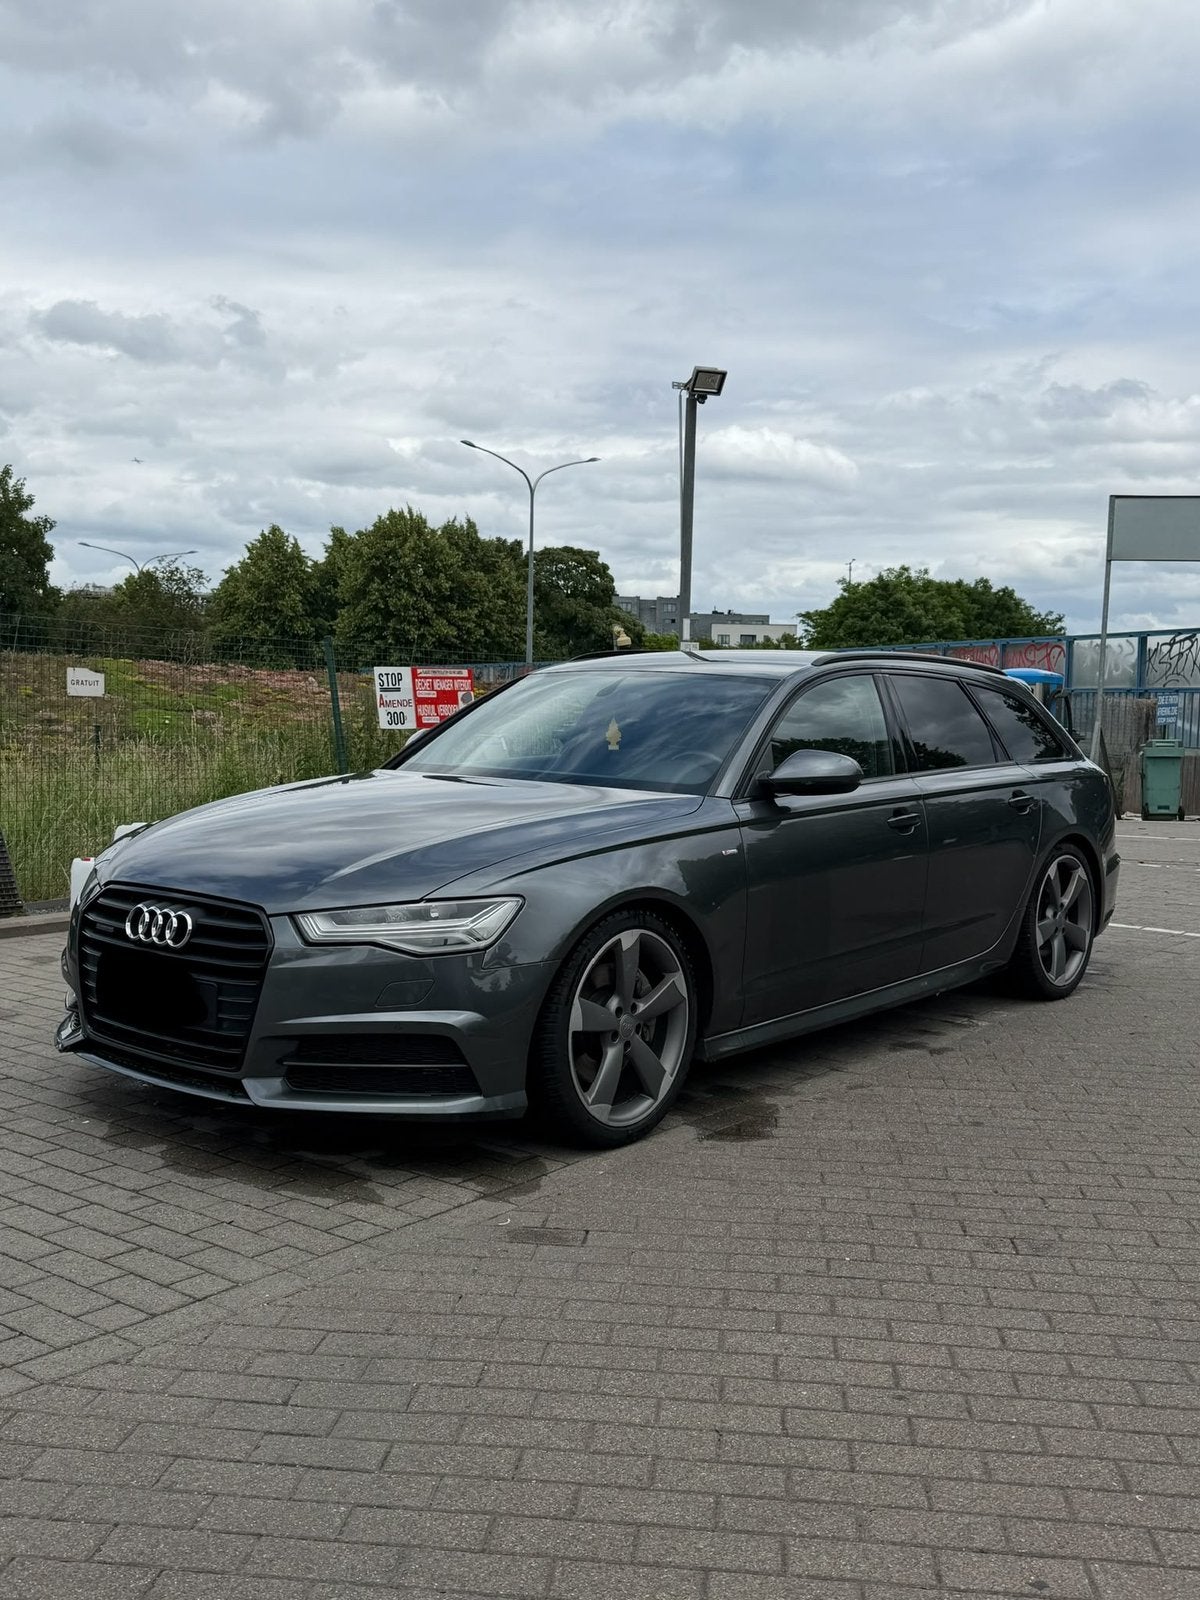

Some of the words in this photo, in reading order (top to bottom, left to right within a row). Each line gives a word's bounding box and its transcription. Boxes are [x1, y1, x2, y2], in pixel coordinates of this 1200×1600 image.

[70, 679, 100, 687] GRATUIT
[378, 672, 403, 687] STOP
[379, 693, 413, 708] AMENDE
[386, 711, 406, 726] 300
